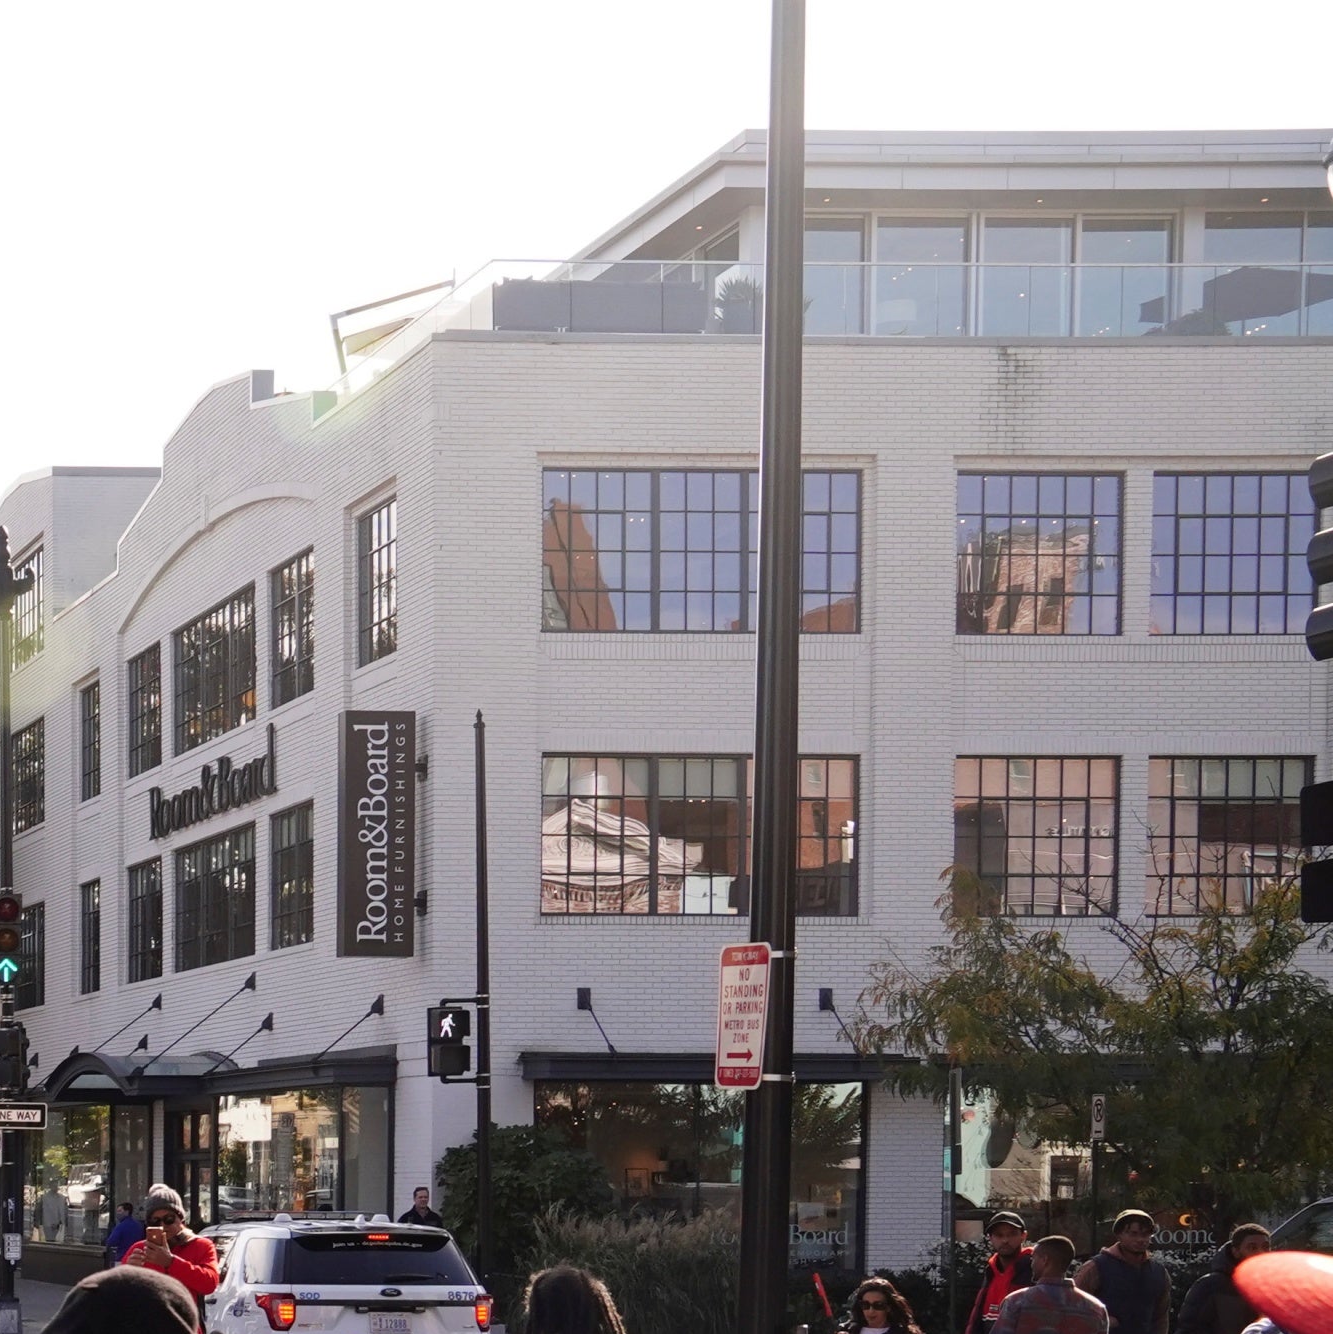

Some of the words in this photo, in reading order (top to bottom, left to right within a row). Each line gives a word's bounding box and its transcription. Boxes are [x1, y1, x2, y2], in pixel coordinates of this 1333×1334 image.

[149, 722, 278, 841] Room&Board
[395, 723, 406, 873] FURNISHINGS
[353, 721, 390, 943] Room&Board
[394, 885, 405, 942] HOME
[739, 967, 750, 982] NO
[724, 984, 764, 999] STANDING
[723, 1003, 732, 1016] OR
[735, 1001, 763, 1015] PARKING
[724, 1020, 745, 1031] METRO
[747, 1019, 759, 1030] BUS
[733, 1033, 750, 1044] ZONE
[16, 1111, 38, 1121] WAY
[299, 1292, 321, 1300] SOD
[447, 1291, 475, 1301] 8676
